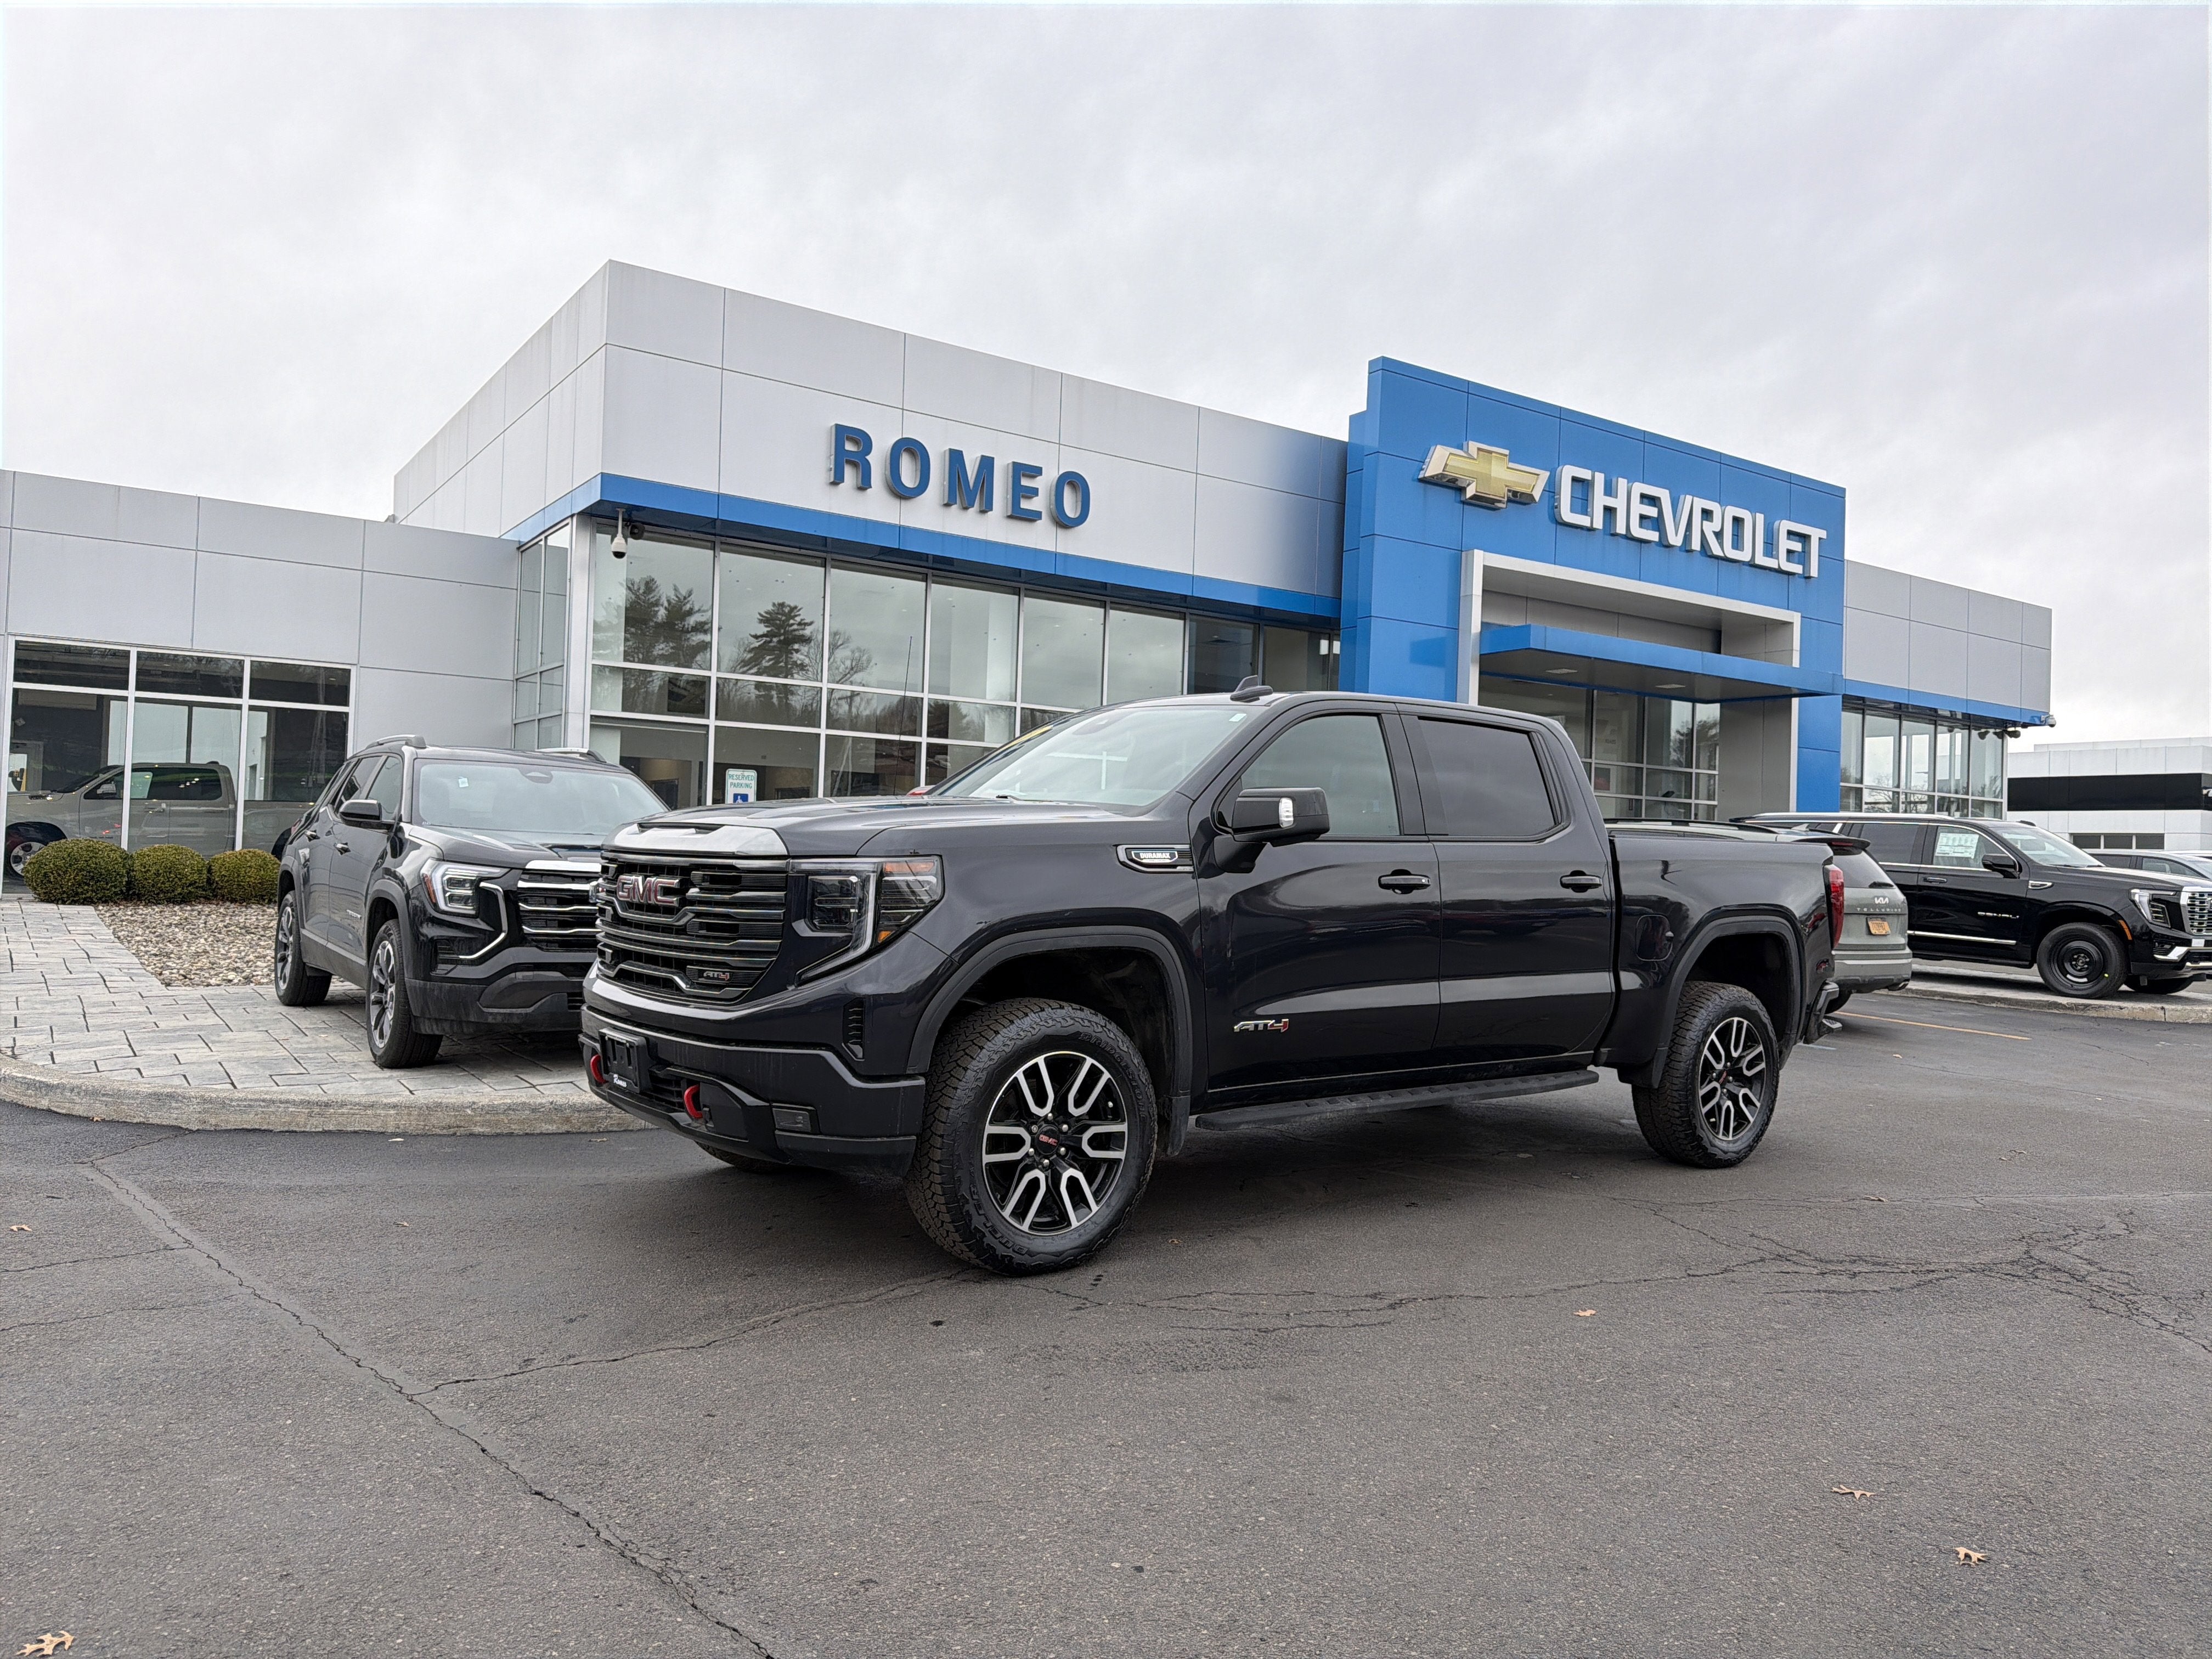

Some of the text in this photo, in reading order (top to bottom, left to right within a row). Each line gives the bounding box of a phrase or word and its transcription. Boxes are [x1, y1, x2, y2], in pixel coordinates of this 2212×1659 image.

[830, 423, 1091, 529] ROMEO
[1554, 464, 1826, 578] CHEVROLET
[617, 874, 680, 907] GMC
[703, 970, 730, 981] AT4
[1233, 1018, 1289, 1033] AT4
[1079, 1031, 1147, 1121] BRIDGESTONE
[1039, 1134, 1058, 1146] GMC
